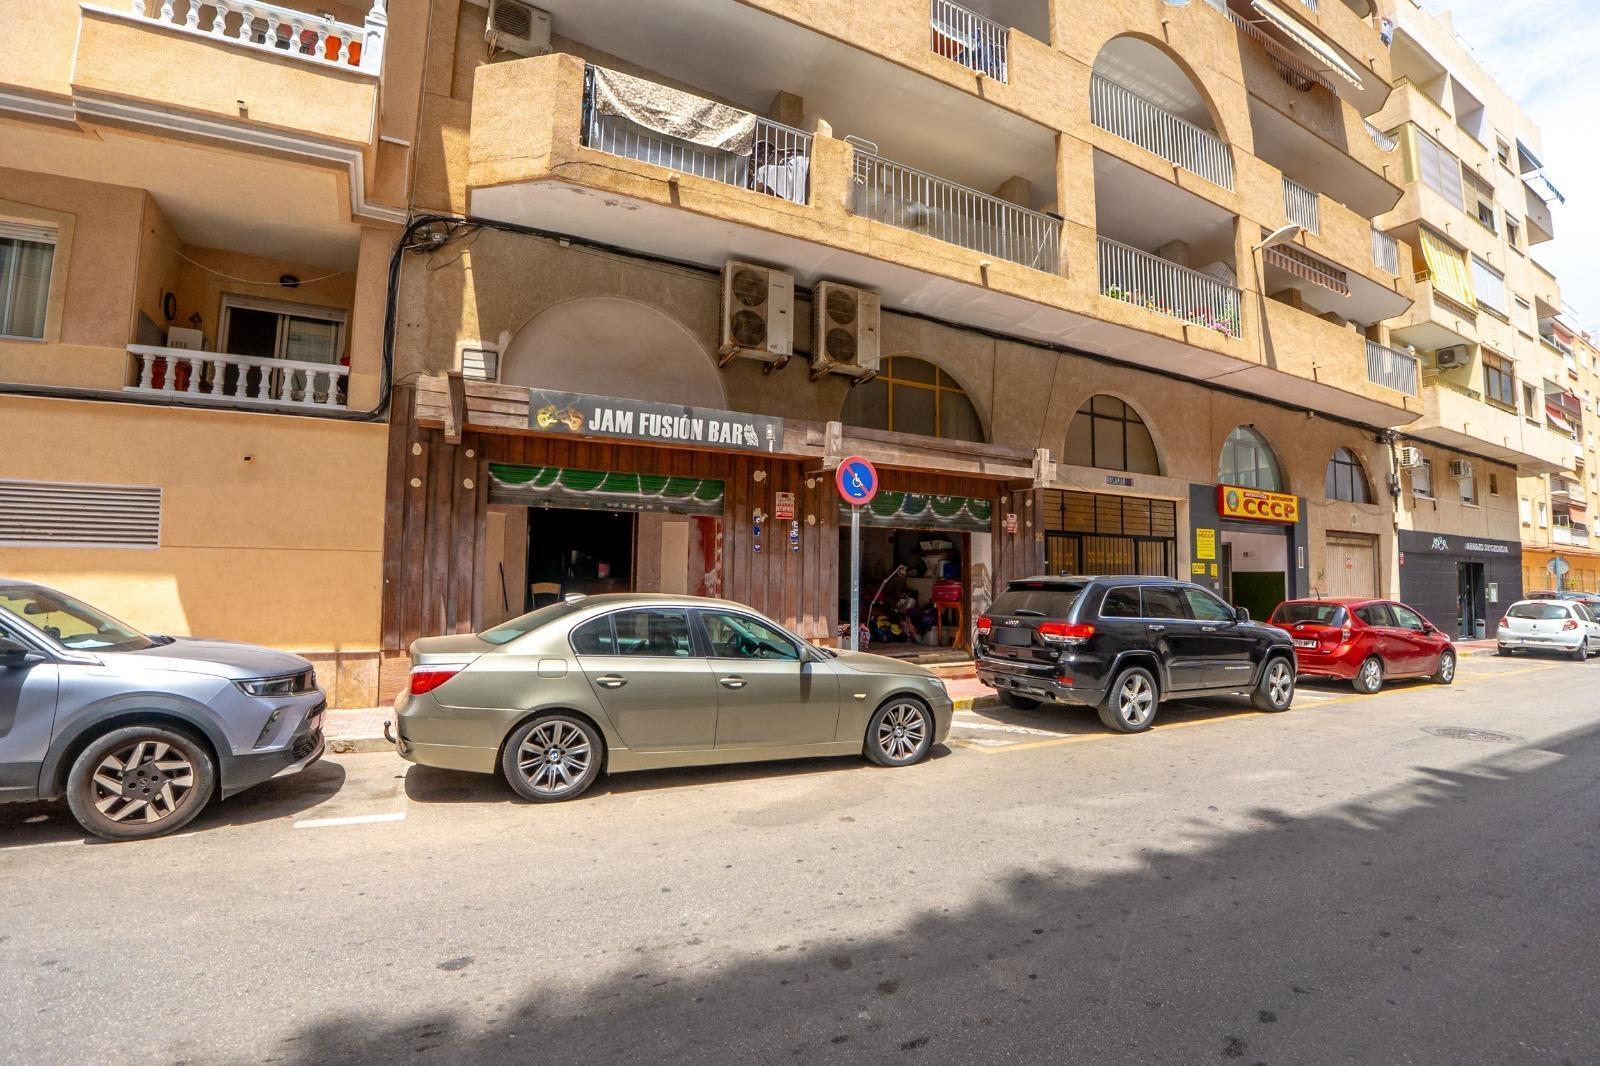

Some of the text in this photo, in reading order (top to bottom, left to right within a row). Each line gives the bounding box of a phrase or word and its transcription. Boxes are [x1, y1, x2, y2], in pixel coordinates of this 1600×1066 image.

[588, 407, 743, 445] JAM FUSIÓN BAR
